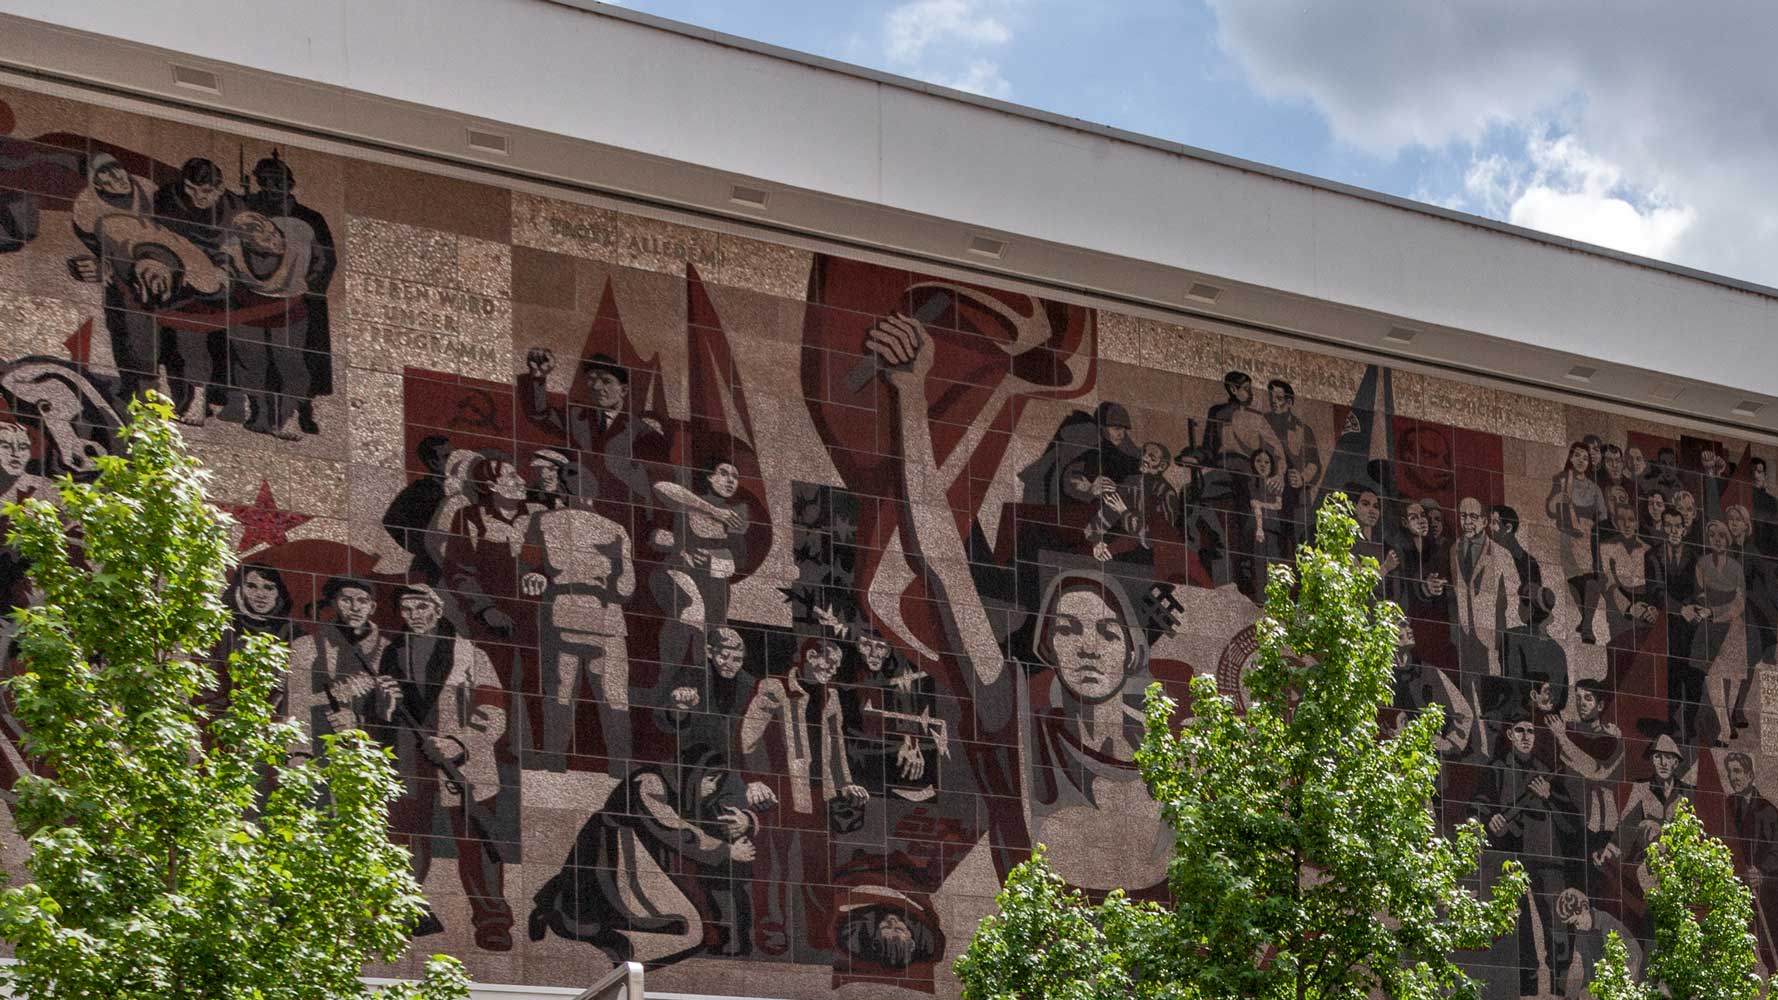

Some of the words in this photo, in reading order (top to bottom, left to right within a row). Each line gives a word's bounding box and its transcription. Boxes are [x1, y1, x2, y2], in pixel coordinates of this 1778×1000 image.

[364, 277, 429, 302] LEBEN
[383, 305, 459, 333] UNSER
[371, 326, 497, 362] PROGRAMM
